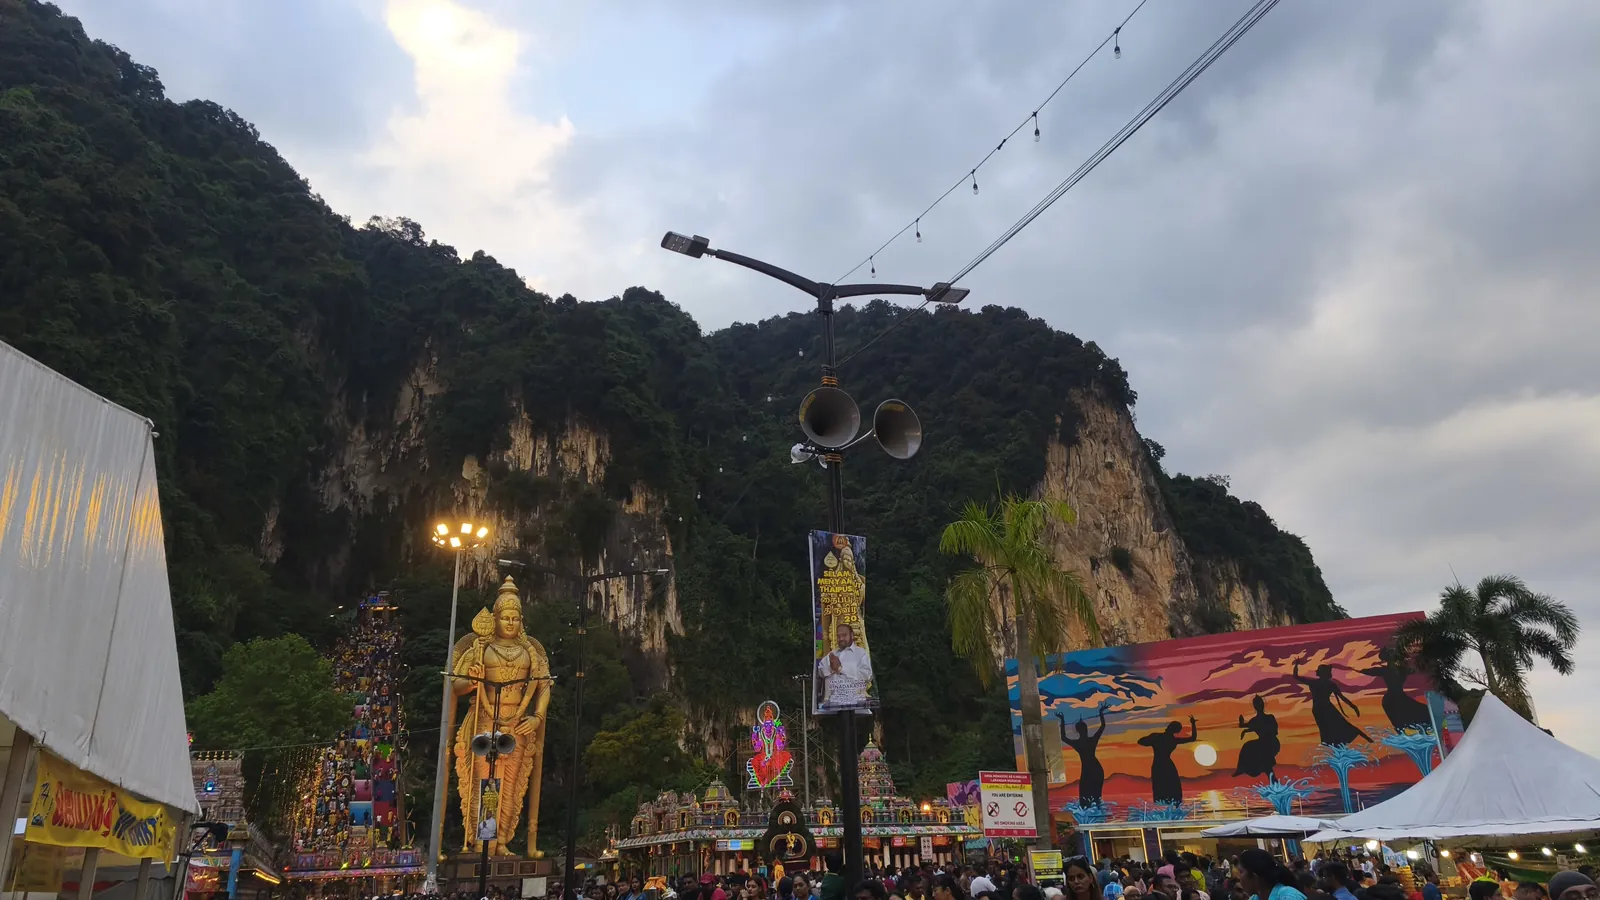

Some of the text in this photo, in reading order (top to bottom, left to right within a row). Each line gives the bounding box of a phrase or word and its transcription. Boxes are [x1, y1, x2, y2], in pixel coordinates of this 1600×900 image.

[824, 571, 855, 579] SELAMT
[818, 578, 861, 588] MENYAMUT
[820, 586, 859, 596] THAIPUSM
